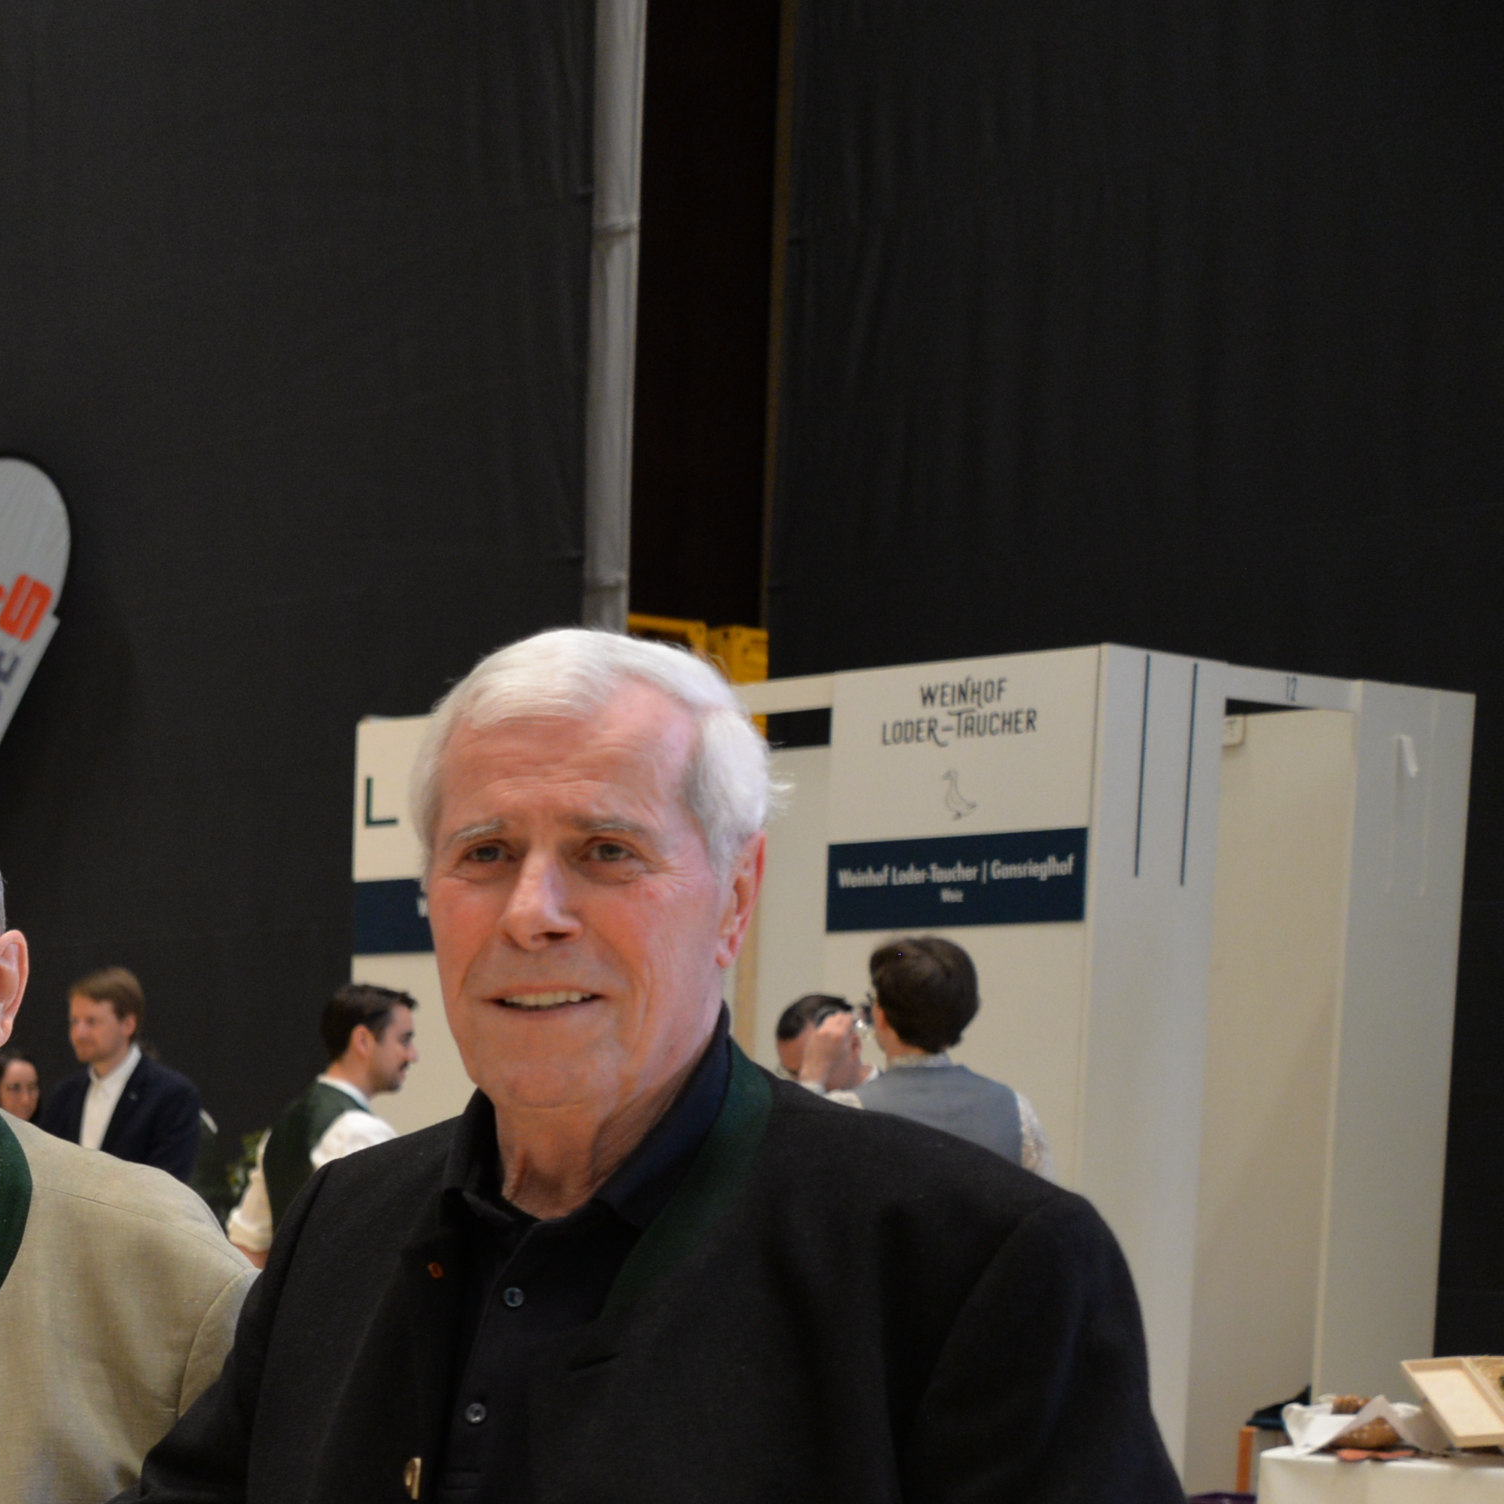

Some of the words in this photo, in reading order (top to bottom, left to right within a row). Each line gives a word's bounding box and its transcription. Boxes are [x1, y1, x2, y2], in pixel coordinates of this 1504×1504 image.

[920, 675, 1007, 709] WEINHOF
[881, 707, 1038, 748] LODER-TAUCHER
[838, 864, 889, 888] Weinhof
[892, 858, 979, 886] Loder-Taucher
[992, 852, 1075, 882] Gansrieglhof
